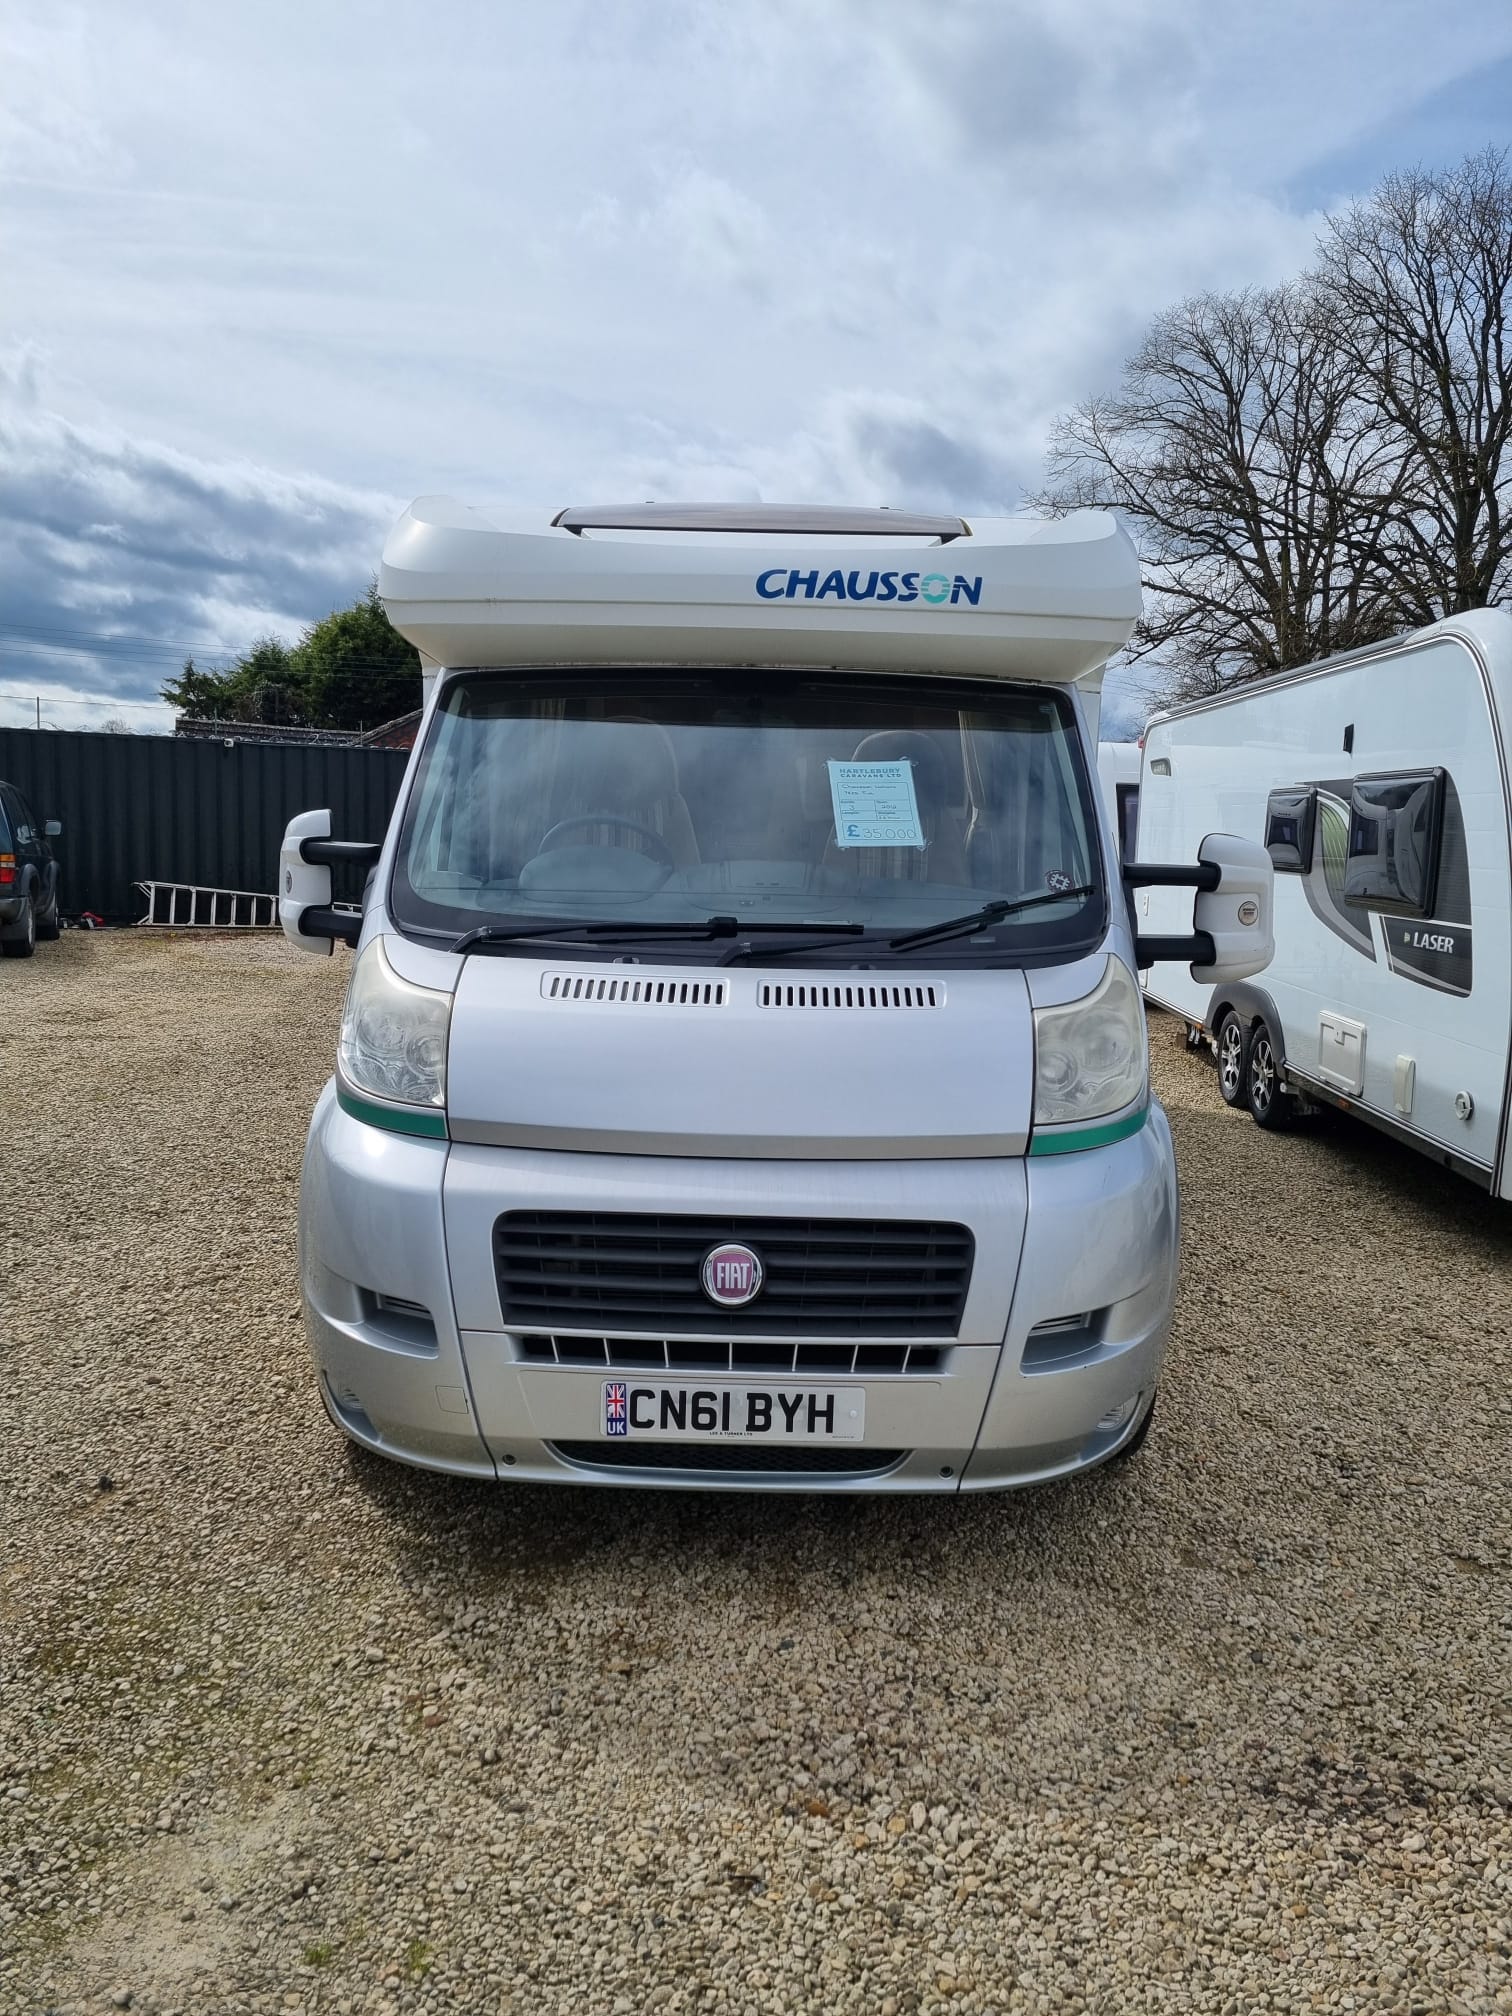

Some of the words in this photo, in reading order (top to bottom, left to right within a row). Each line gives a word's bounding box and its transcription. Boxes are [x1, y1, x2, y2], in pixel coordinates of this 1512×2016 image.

[756, 569, 983, 605] CHAUSSON
[847, 824, 860, 837] £
[1412, 931, 1454, 954] LASER
[716, 1262, 750, 1289] FIAT
[629, 1389, 731, 1432] CN61
[745, 1392, 835, 1434] BYH
[607, 1421, 625, 1434] UK
